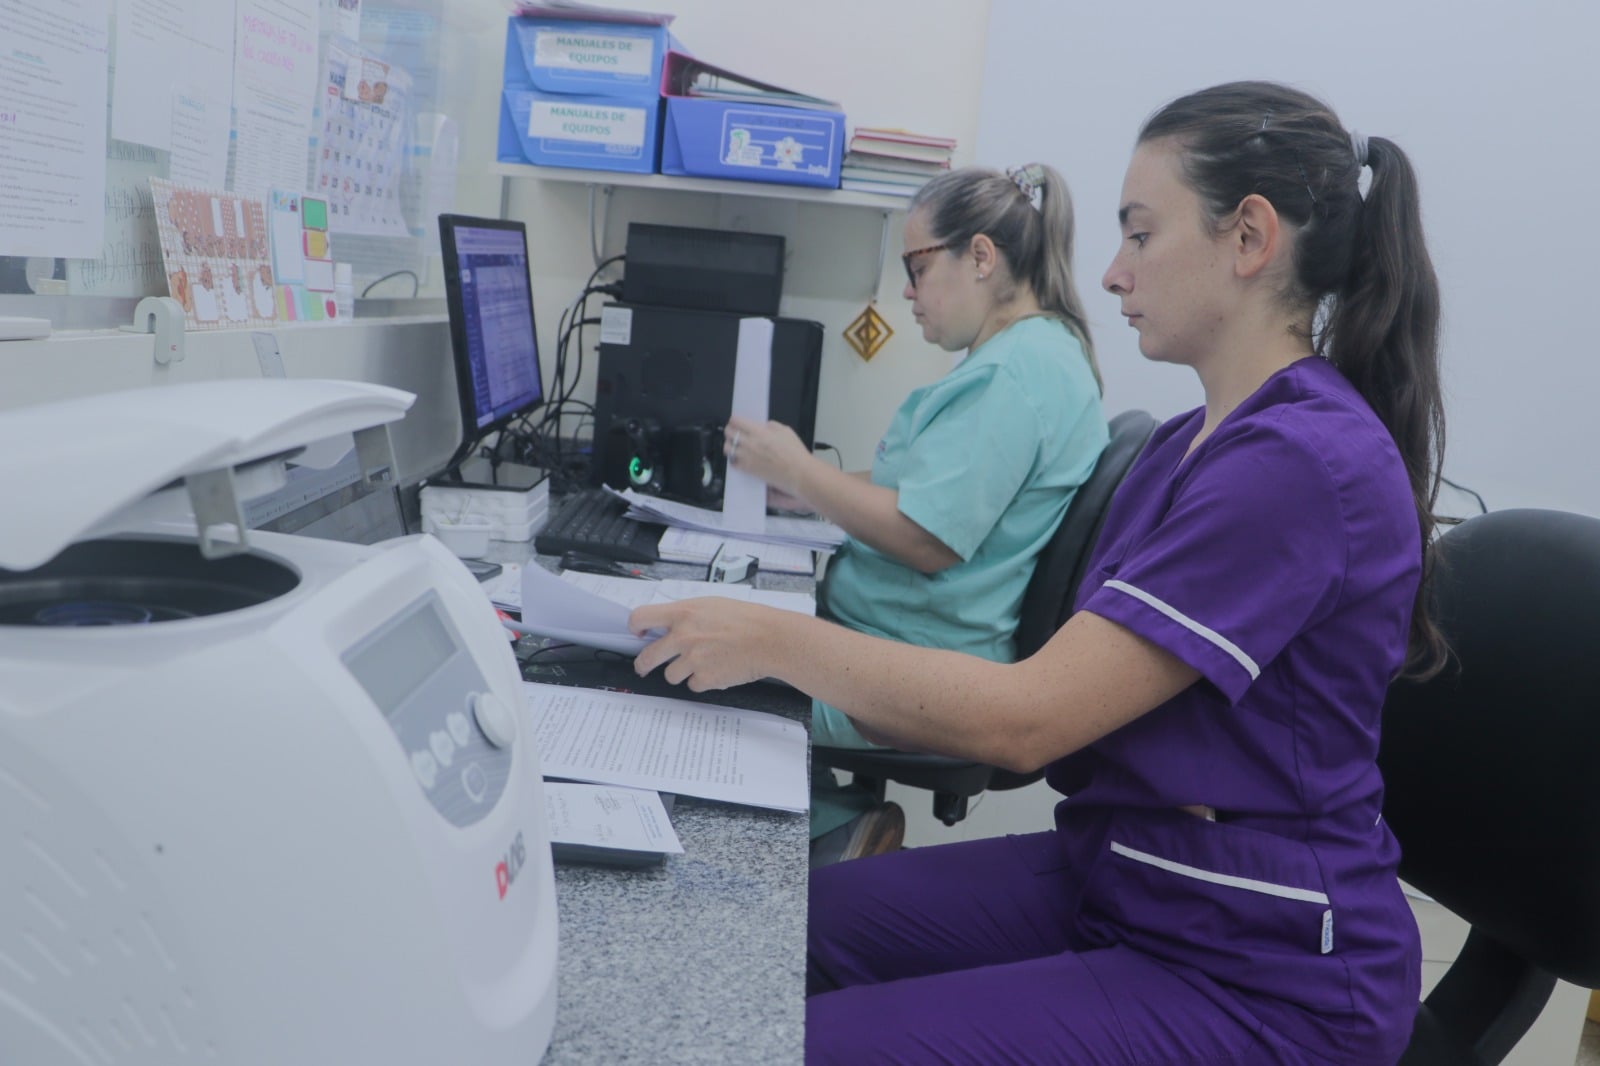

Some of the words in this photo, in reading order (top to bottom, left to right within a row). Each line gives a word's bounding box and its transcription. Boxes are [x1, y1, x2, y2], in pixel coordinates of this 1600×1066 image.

[556, 37, 616, 51] MANUALES
[617, 42, 632, 52] DE
[568, 52, 619, 66] EQUIPOS
[550, 106, 610, 120] MANUALES
[611, 111, 627, 122] DE
[561, 122, 611, 136] EQUIPOS
